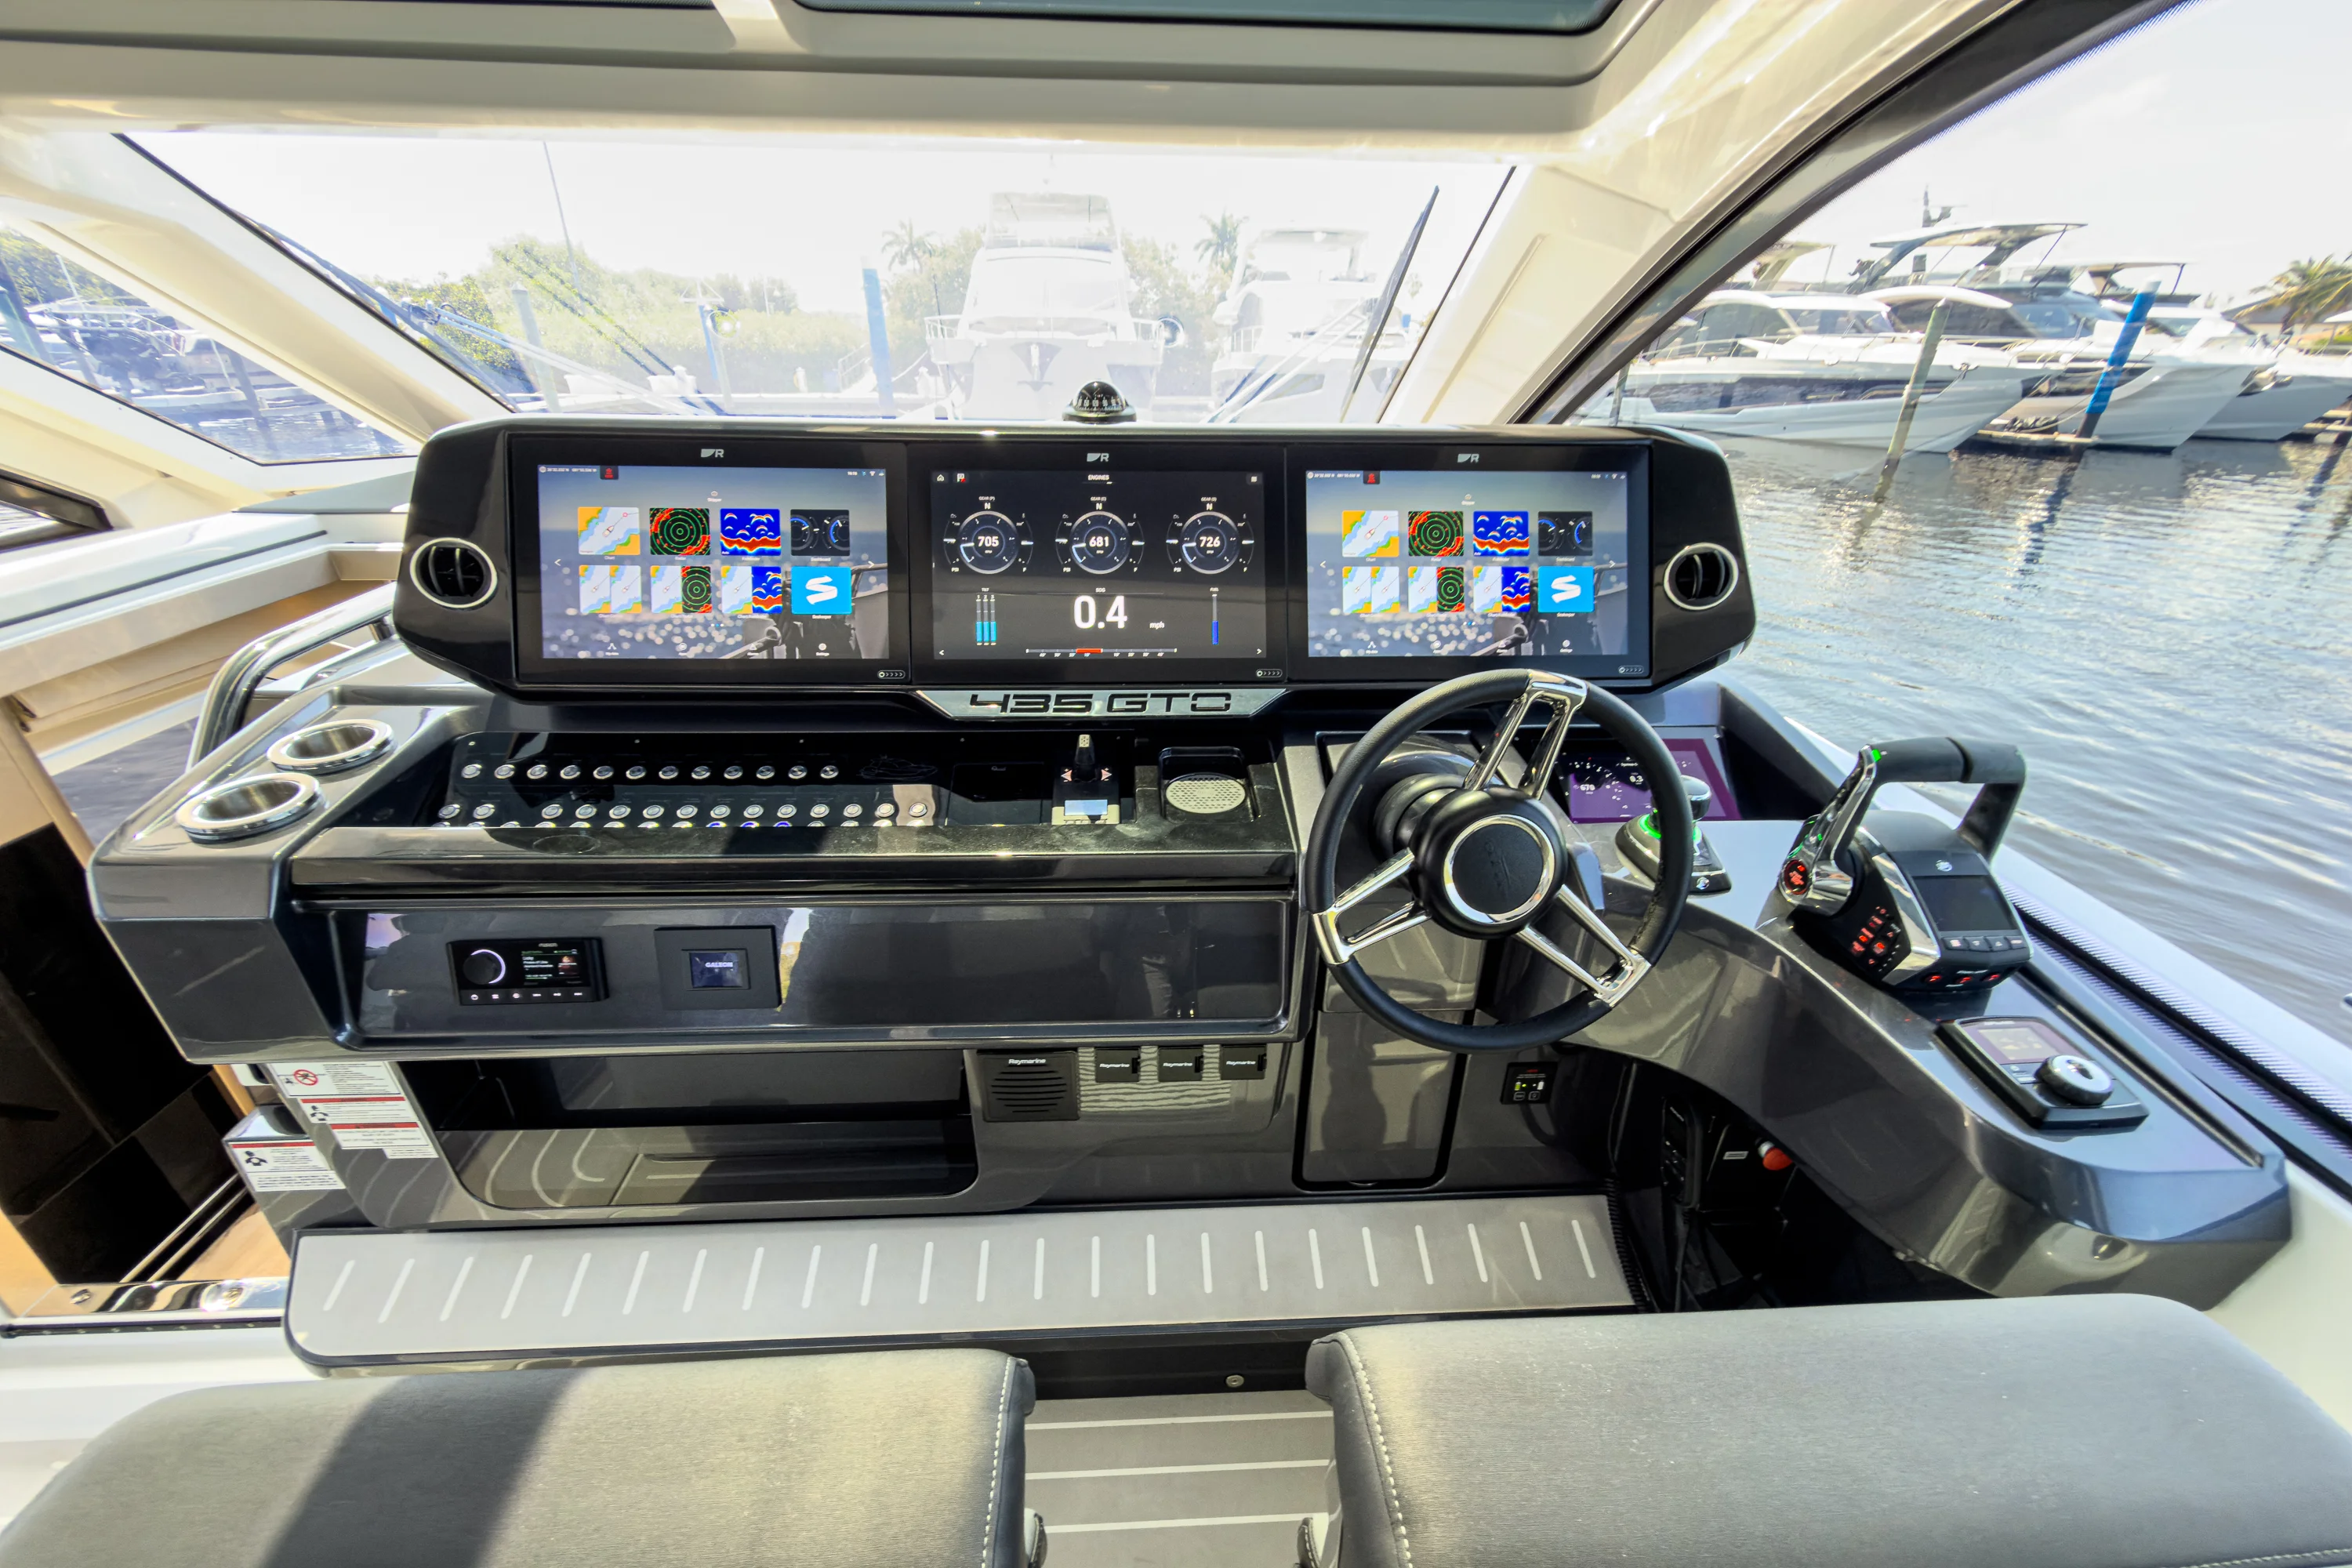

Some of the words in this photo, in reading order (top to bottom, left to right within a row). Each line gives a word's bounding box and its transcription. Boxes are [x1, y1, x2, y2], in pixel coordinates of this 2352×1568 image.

[978, 536, 1000, 547] 705
[1089, 536, 1109, 547] 681
[1200, 536, 1221, 547] 726
[1073, 595, 1128, 629] 0.4
[1149, 621, 1165, 630] mph
[970, 693, 1094, 714] 435
[1106, 692, 1232, 713] GTO
